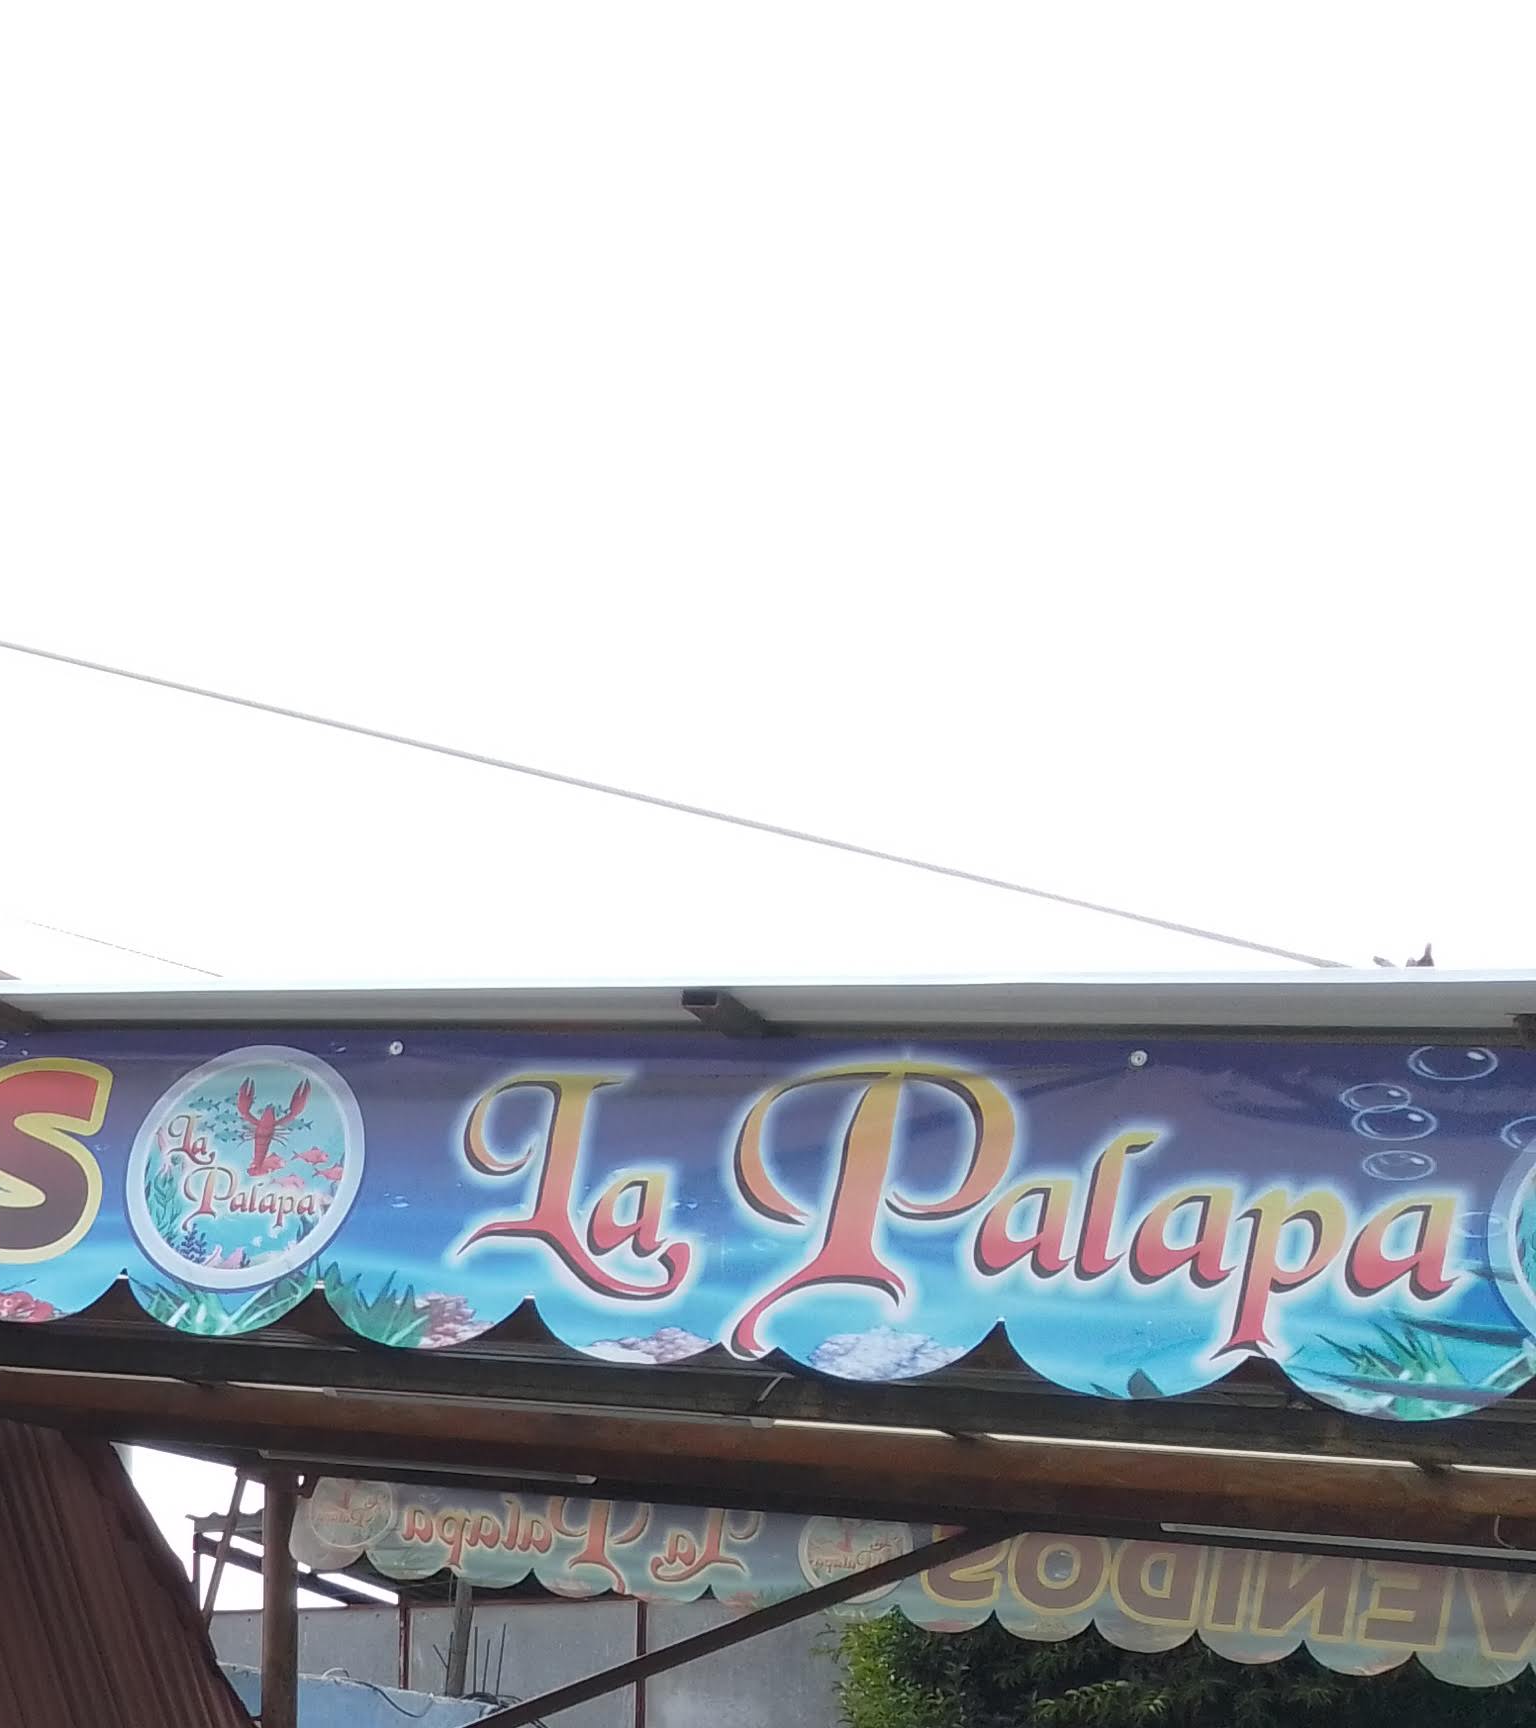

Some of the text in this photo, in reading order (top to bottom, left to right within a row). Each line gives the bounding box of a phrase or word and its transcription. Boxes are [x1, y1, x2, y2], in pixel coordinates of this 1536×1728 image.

[167, 1114, 216, 1165] La
[181, 1166, 317, 1232] Palapa
[454, 1060, 1464, 1360] La Palapa
